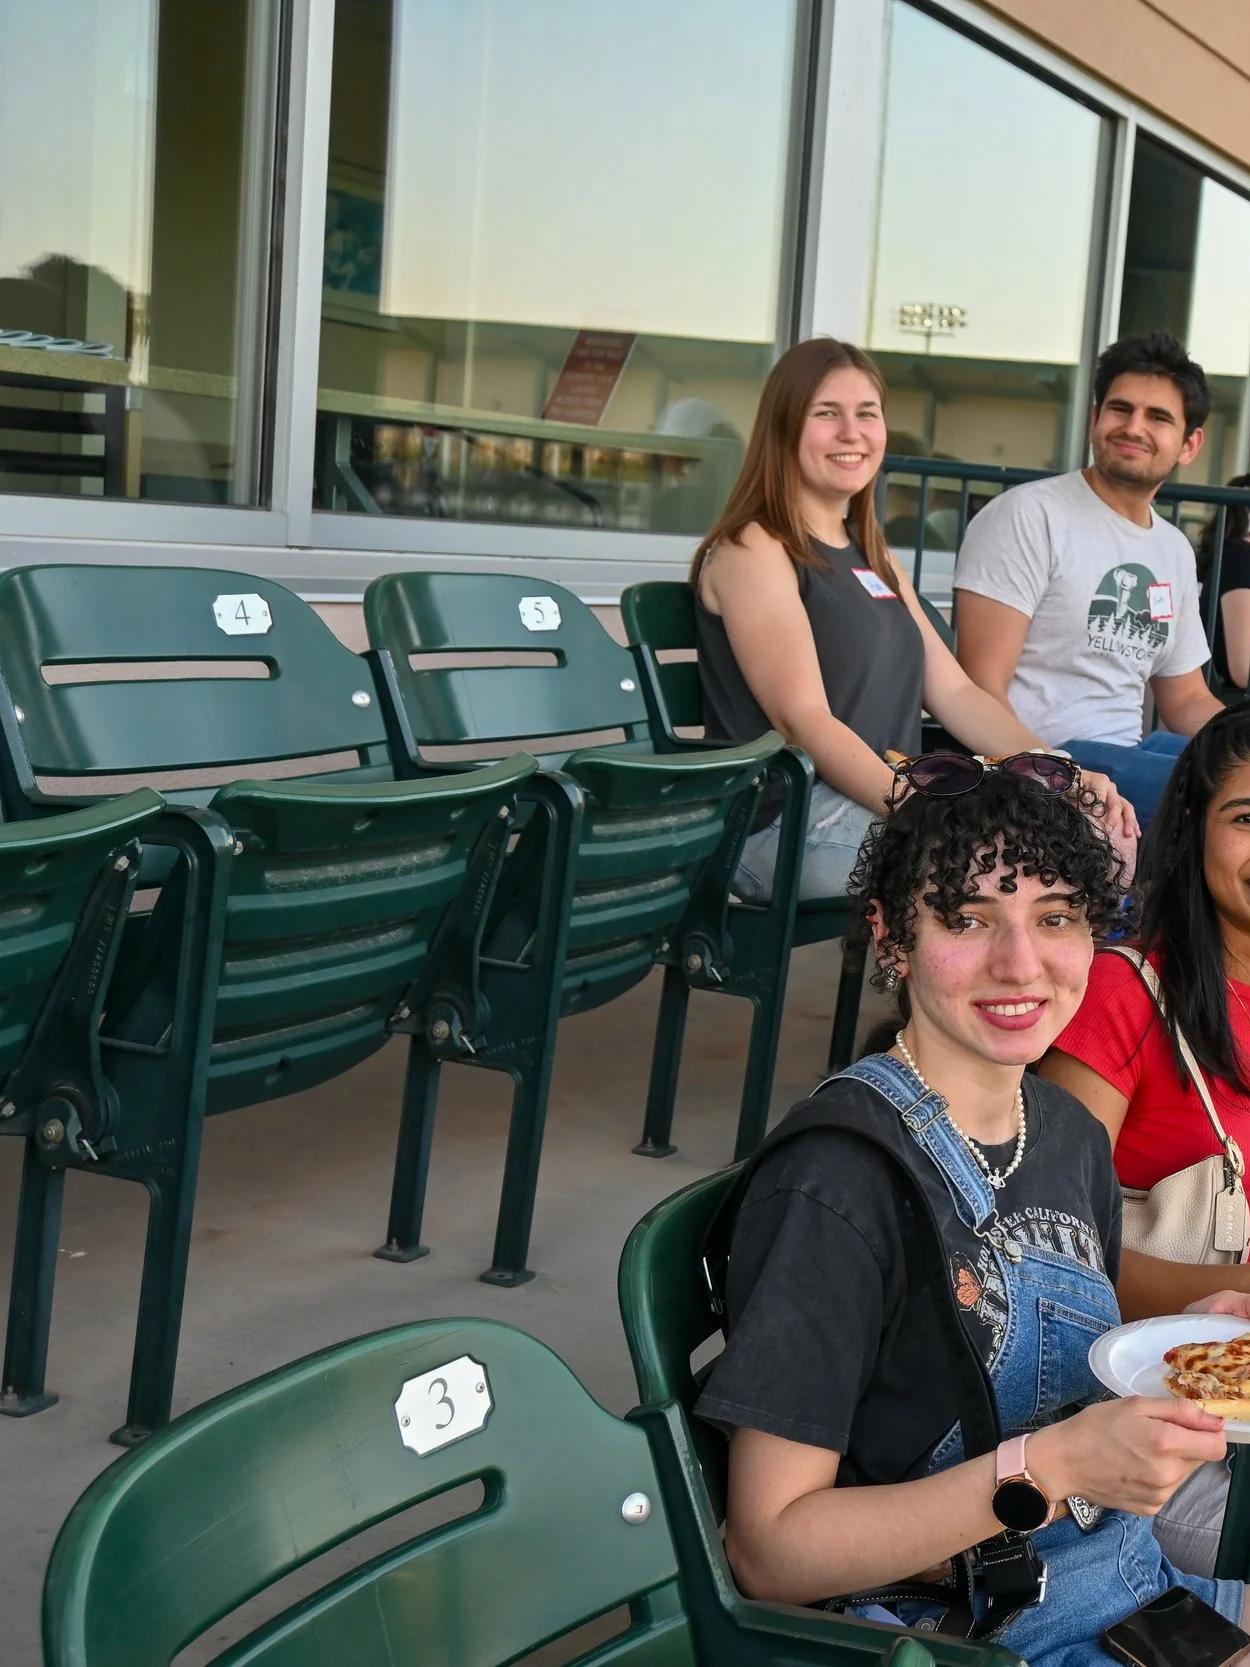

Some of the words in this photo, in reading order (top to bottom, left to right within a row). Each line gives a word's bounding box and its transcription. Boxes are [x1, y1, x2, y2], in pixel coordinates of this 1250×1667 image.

[234, 599, 251, 626] 4
[533, 601, 545, 624] 5
[427, 1377, 456, 1430] 3
